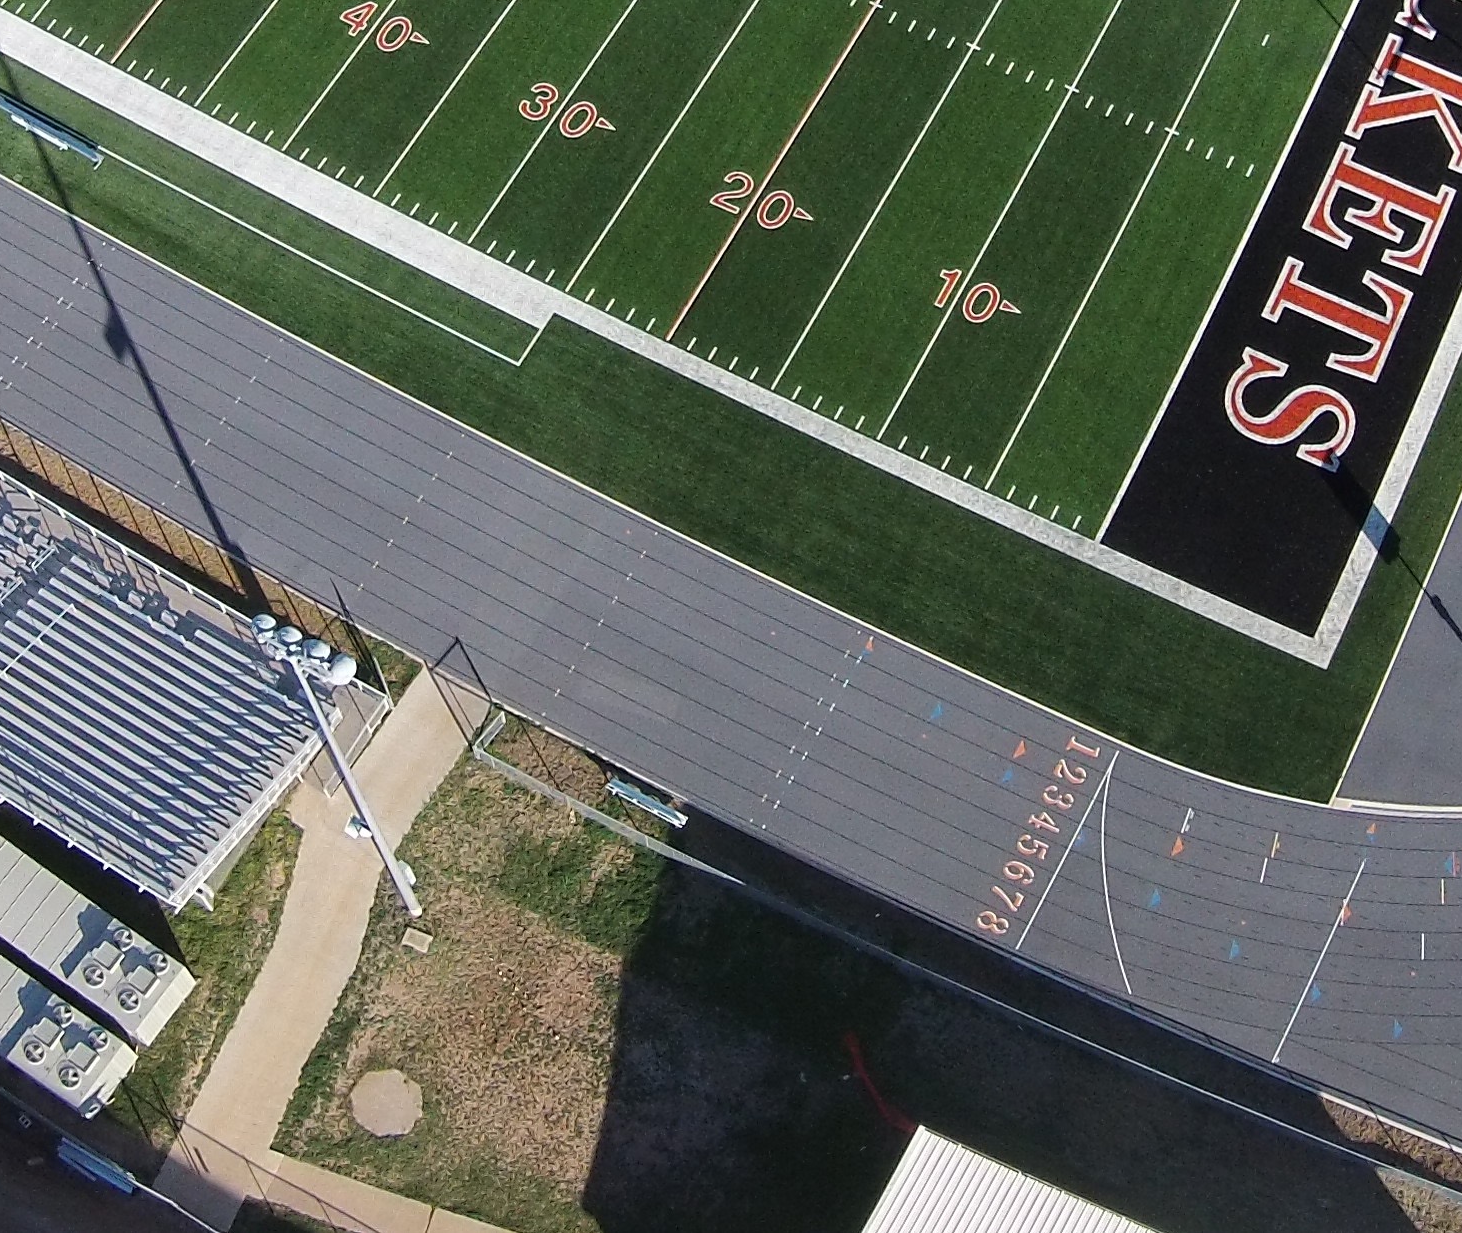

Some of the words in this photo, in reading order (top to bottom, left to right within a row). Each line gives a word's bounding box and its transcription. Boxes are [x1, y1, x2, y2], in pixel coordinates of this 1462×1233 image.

[339, 1, 412, 53] 40
[519, 83, 596, 138] 30
[710, 171, 793, 230] 20
[933, 269, 1000, 325] 10
